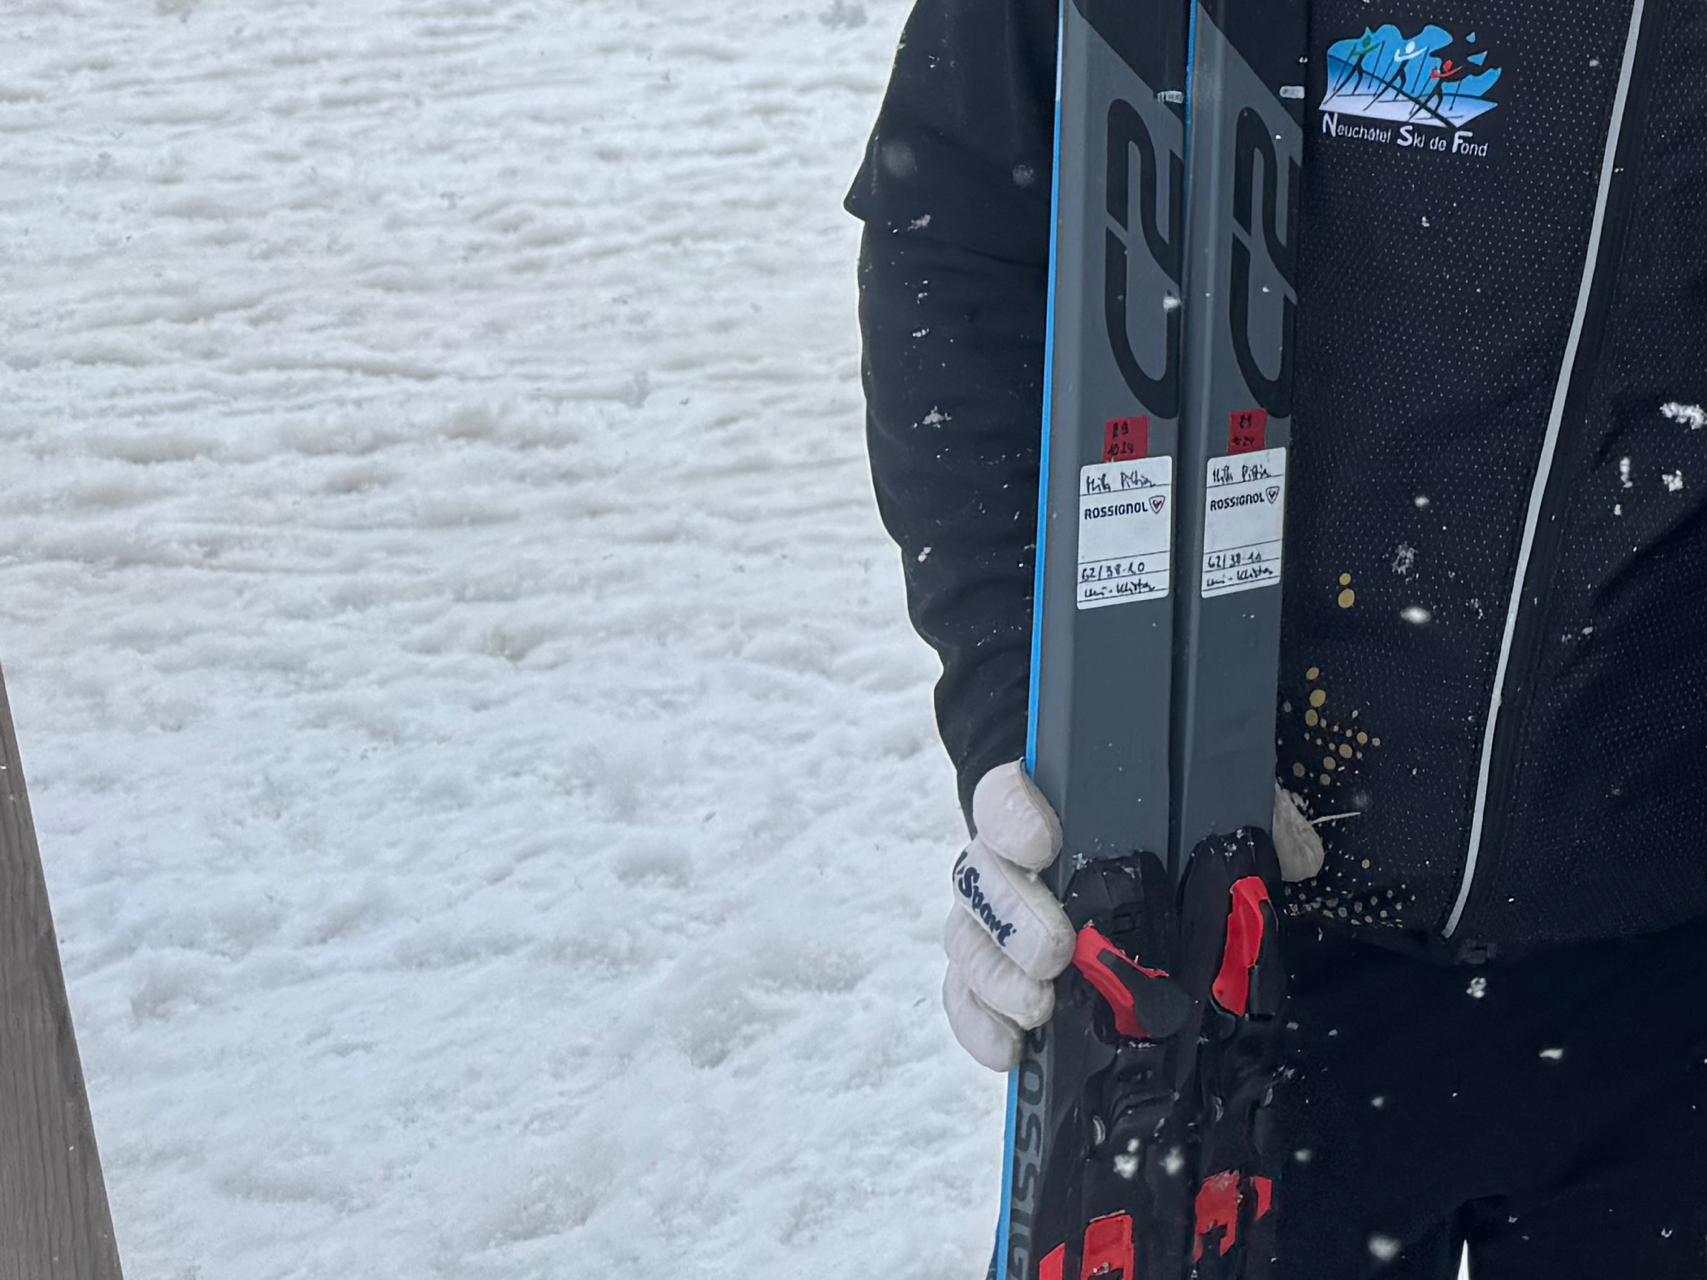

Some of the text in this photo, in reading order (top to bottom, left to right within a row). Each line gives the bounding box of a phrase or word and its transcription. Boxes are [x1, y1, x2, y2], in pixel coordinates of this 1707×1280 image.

[1430, 134, 1447, 152] de
[1452, 130, 1488, 158] Fond
[1084, 502, 1149, 521] ROSSIGNOL
[1209, 493, 1264, 512] ROSSIGNOL
